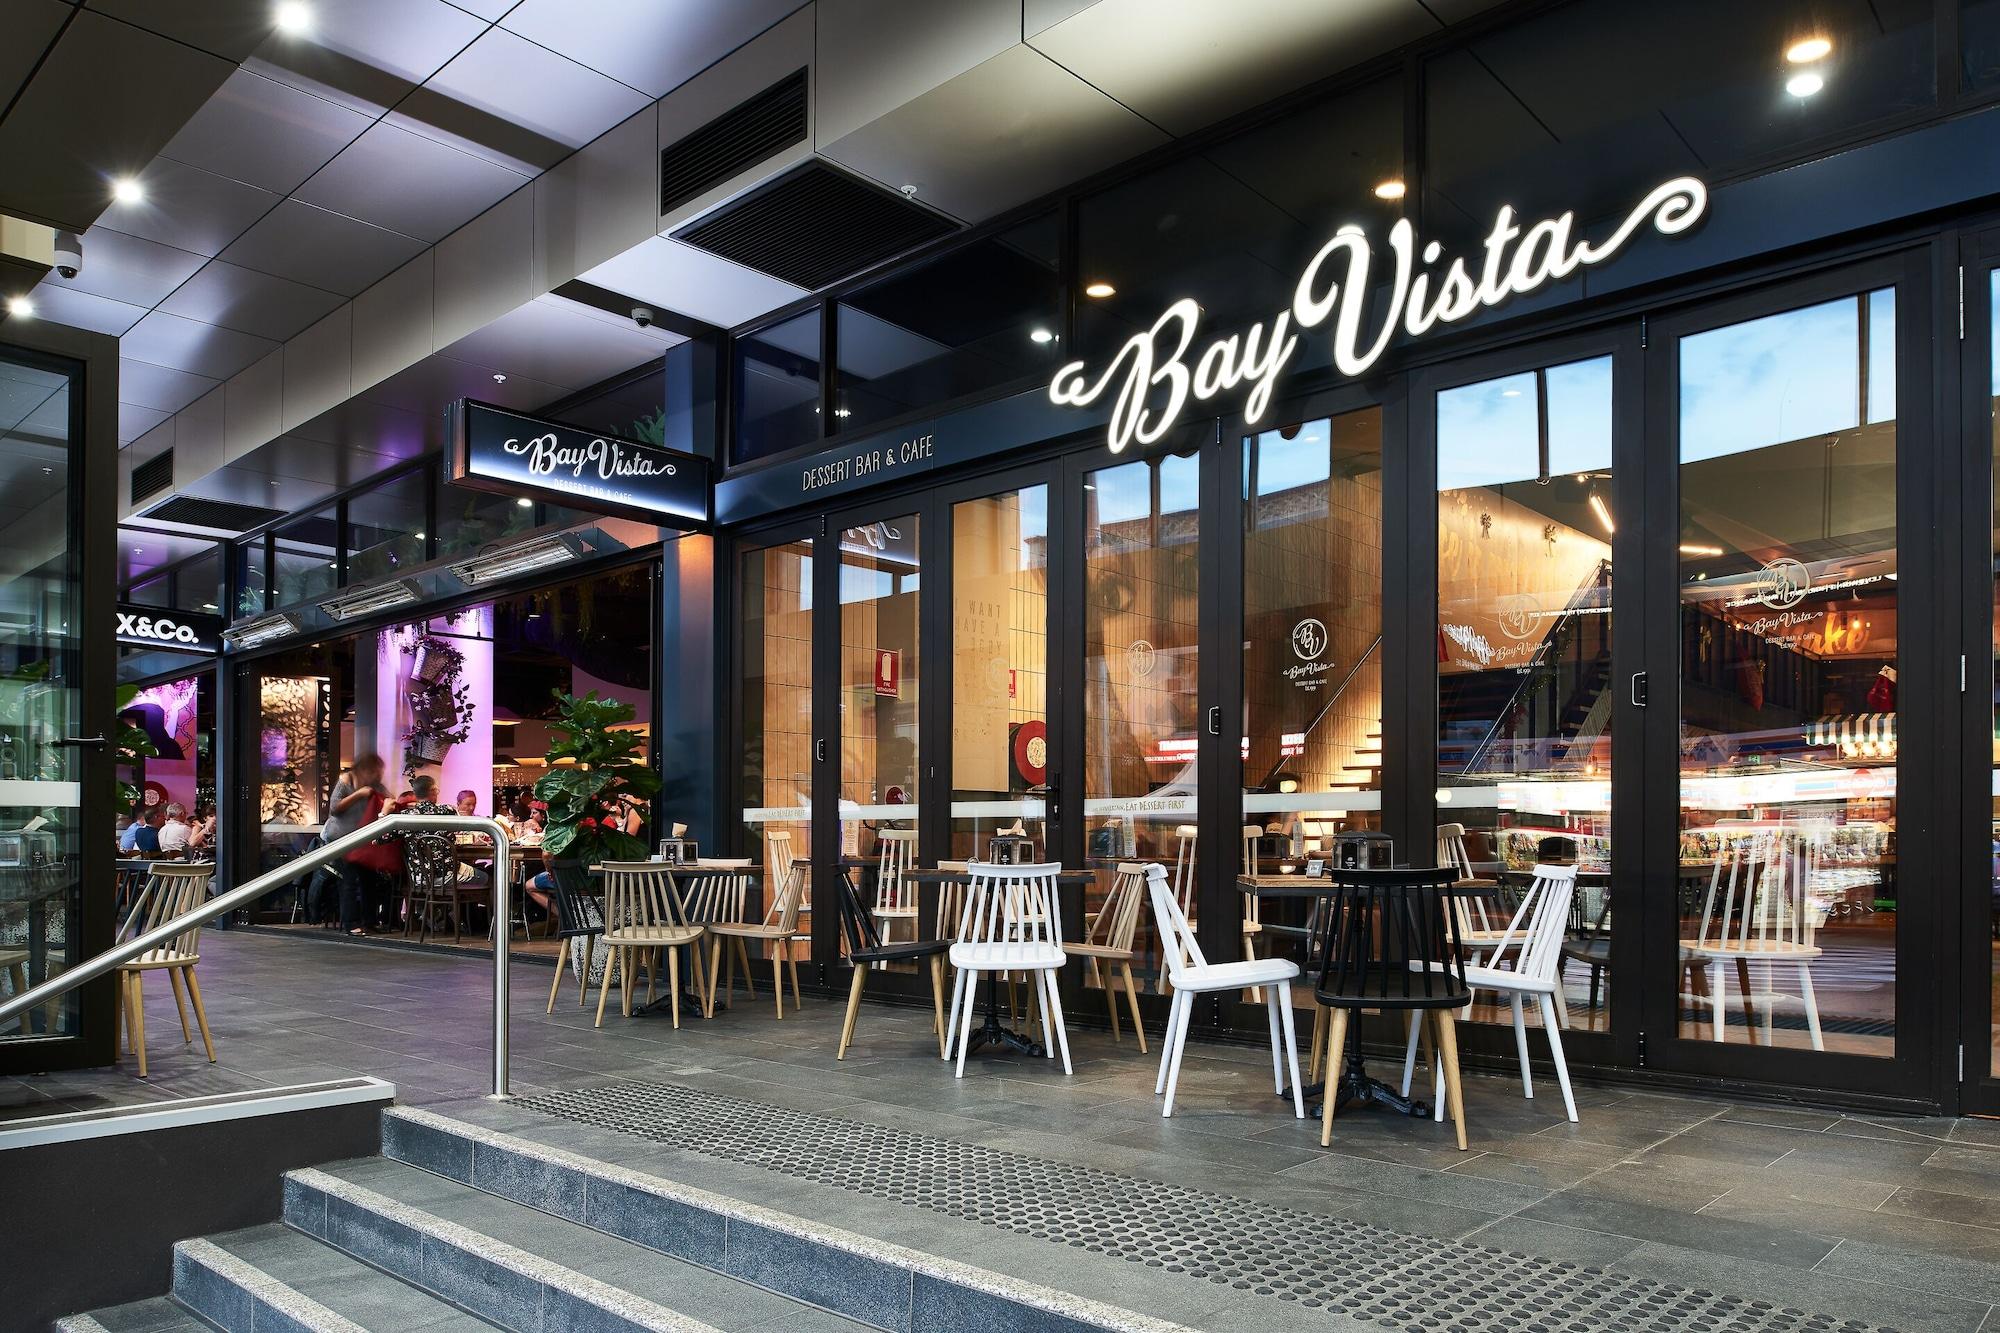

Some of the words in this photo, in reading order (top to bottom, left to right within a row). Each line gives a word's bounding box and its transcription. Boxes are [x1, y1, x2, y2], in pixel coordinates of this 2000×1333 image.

[1048, 297, 1298, 455] Bay
[1293, 175, 1709, 377] Vista
[504, 433, 588, 478] Bay
[587, 438, 676, 480] Vista
[803, 459, 851, 491] DESSERT
[856, 451, 880, 477] BAR
[886, 448, 896, 466] &
[901, 435, 933, 464] CAFE
[968, 600, 1001, 618] WANT
[1743, 617, 1780, 635] Bay
[1779, 611, 1824, 628] Vista
[1495, 646, 1517, 661] Bay
[1516, 640, 1553, 656] Vista
[1283, 665, 1307, 680] Bay
[1306, 663, 1335, 675] Vista
[1125, 802, 1137, 811] EAT
[1139, 801, 1166, 811] DESSERT
[1168, 800, 1185, 809] FIRST
